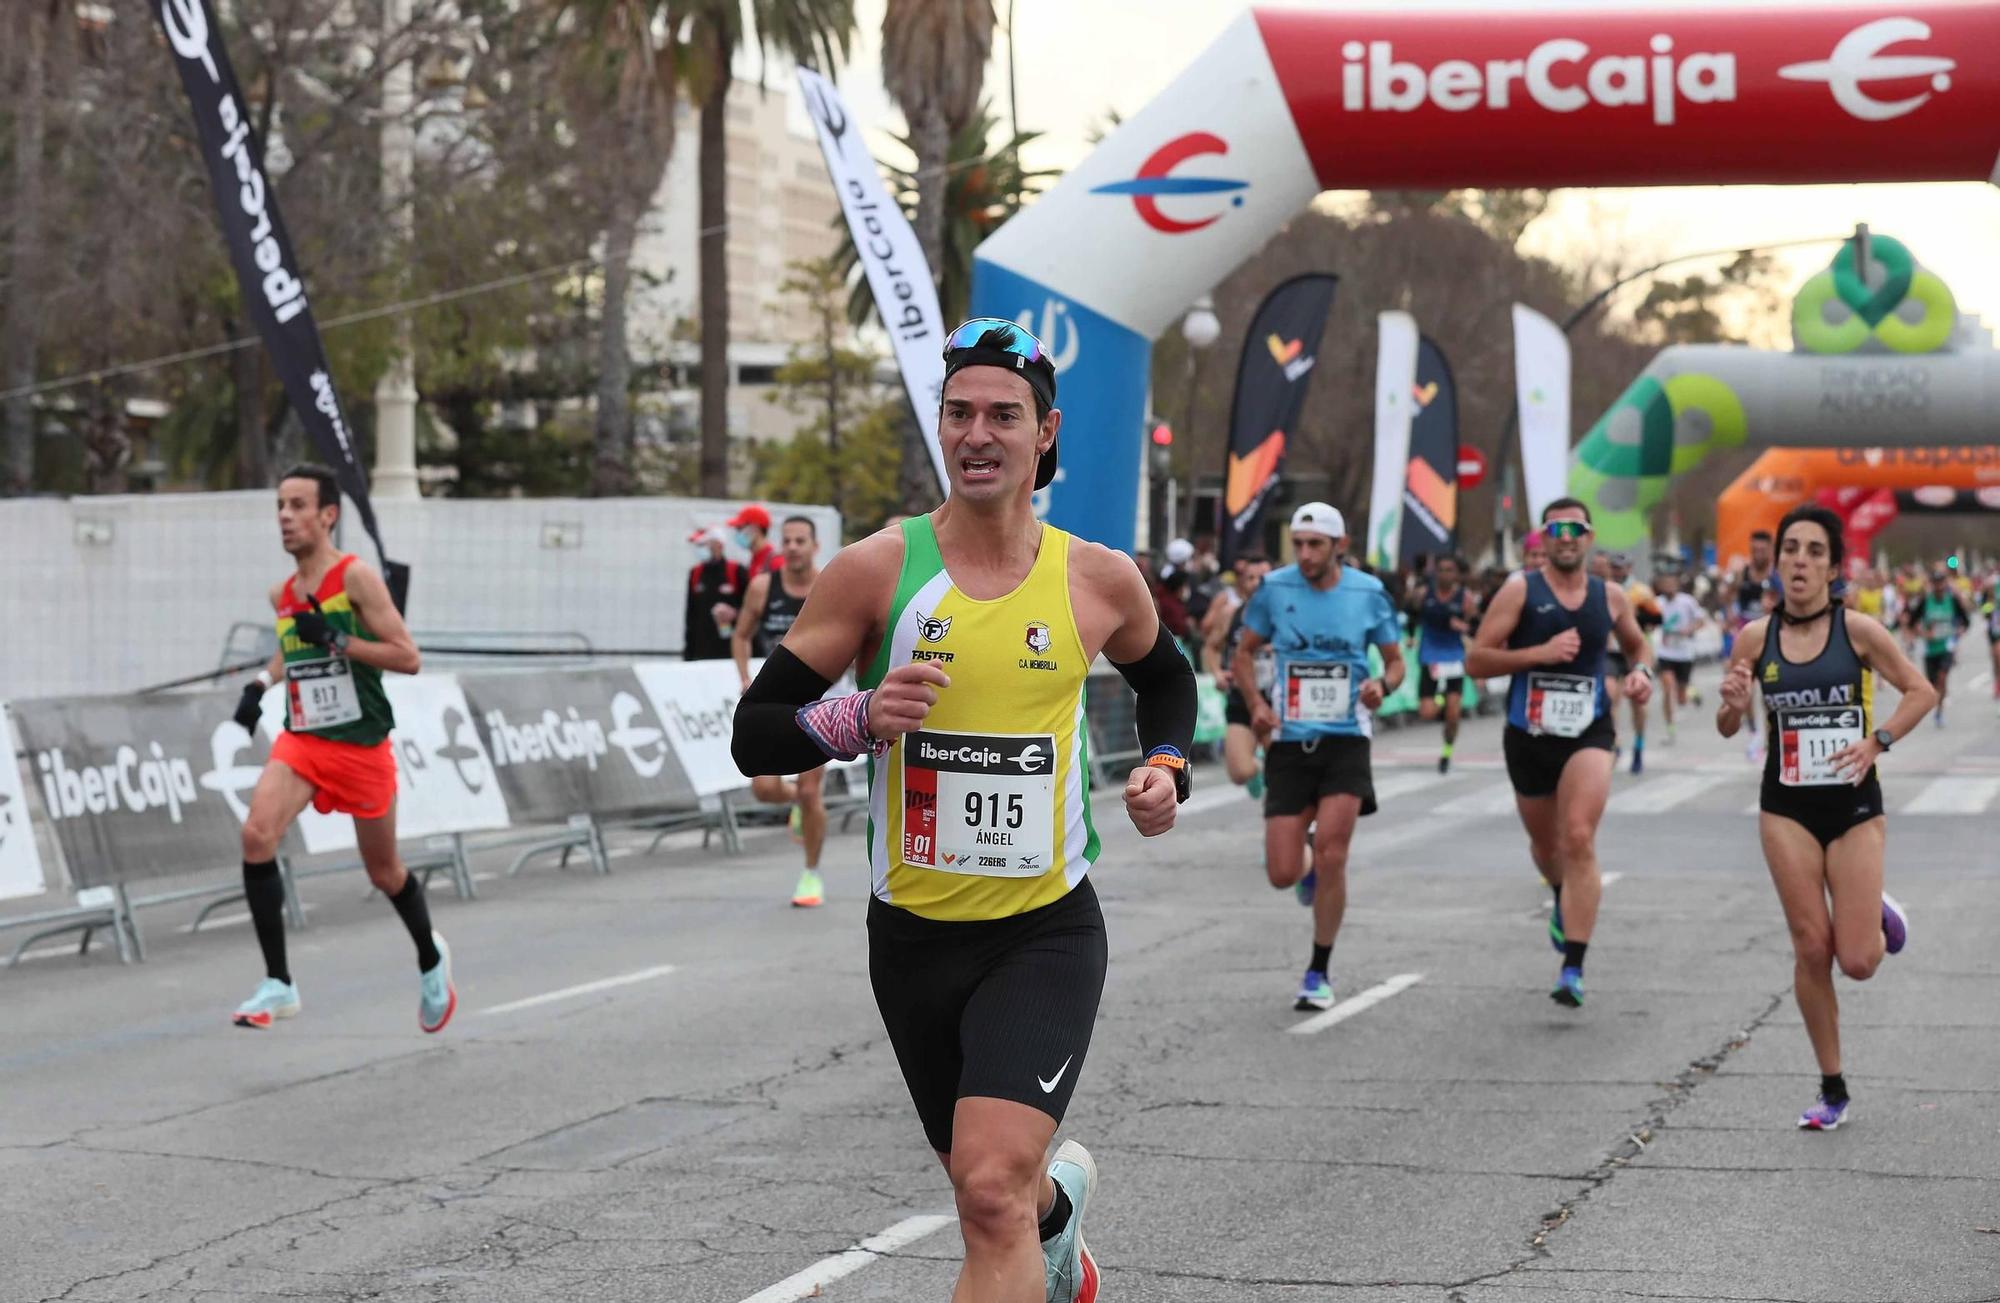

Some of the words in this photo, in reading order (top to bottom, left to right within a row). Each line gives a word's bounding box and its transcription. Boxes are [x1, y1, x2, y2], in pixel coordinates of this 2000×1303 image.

[1342, 34, 1737, 125] iberCaja
[848, 180, 929, 340] iberCaja
[912, 650, 954, 662] FASTER
[1030, 660, 1058, 671] MEMBRILLA
[313, 685, 337, 704] 817
[486, 706, 608, 771] iberCaja
[920, 742, 1002, 767] iberCaja
[38, 740, 198, 824] iberCaja
[964, 791, 1024, 829] 915
[914, 835, 931, 855] 01
[976, 829, 1014, 846] ÁNGEL
[978, 856, 1007, 867] 226ERS
